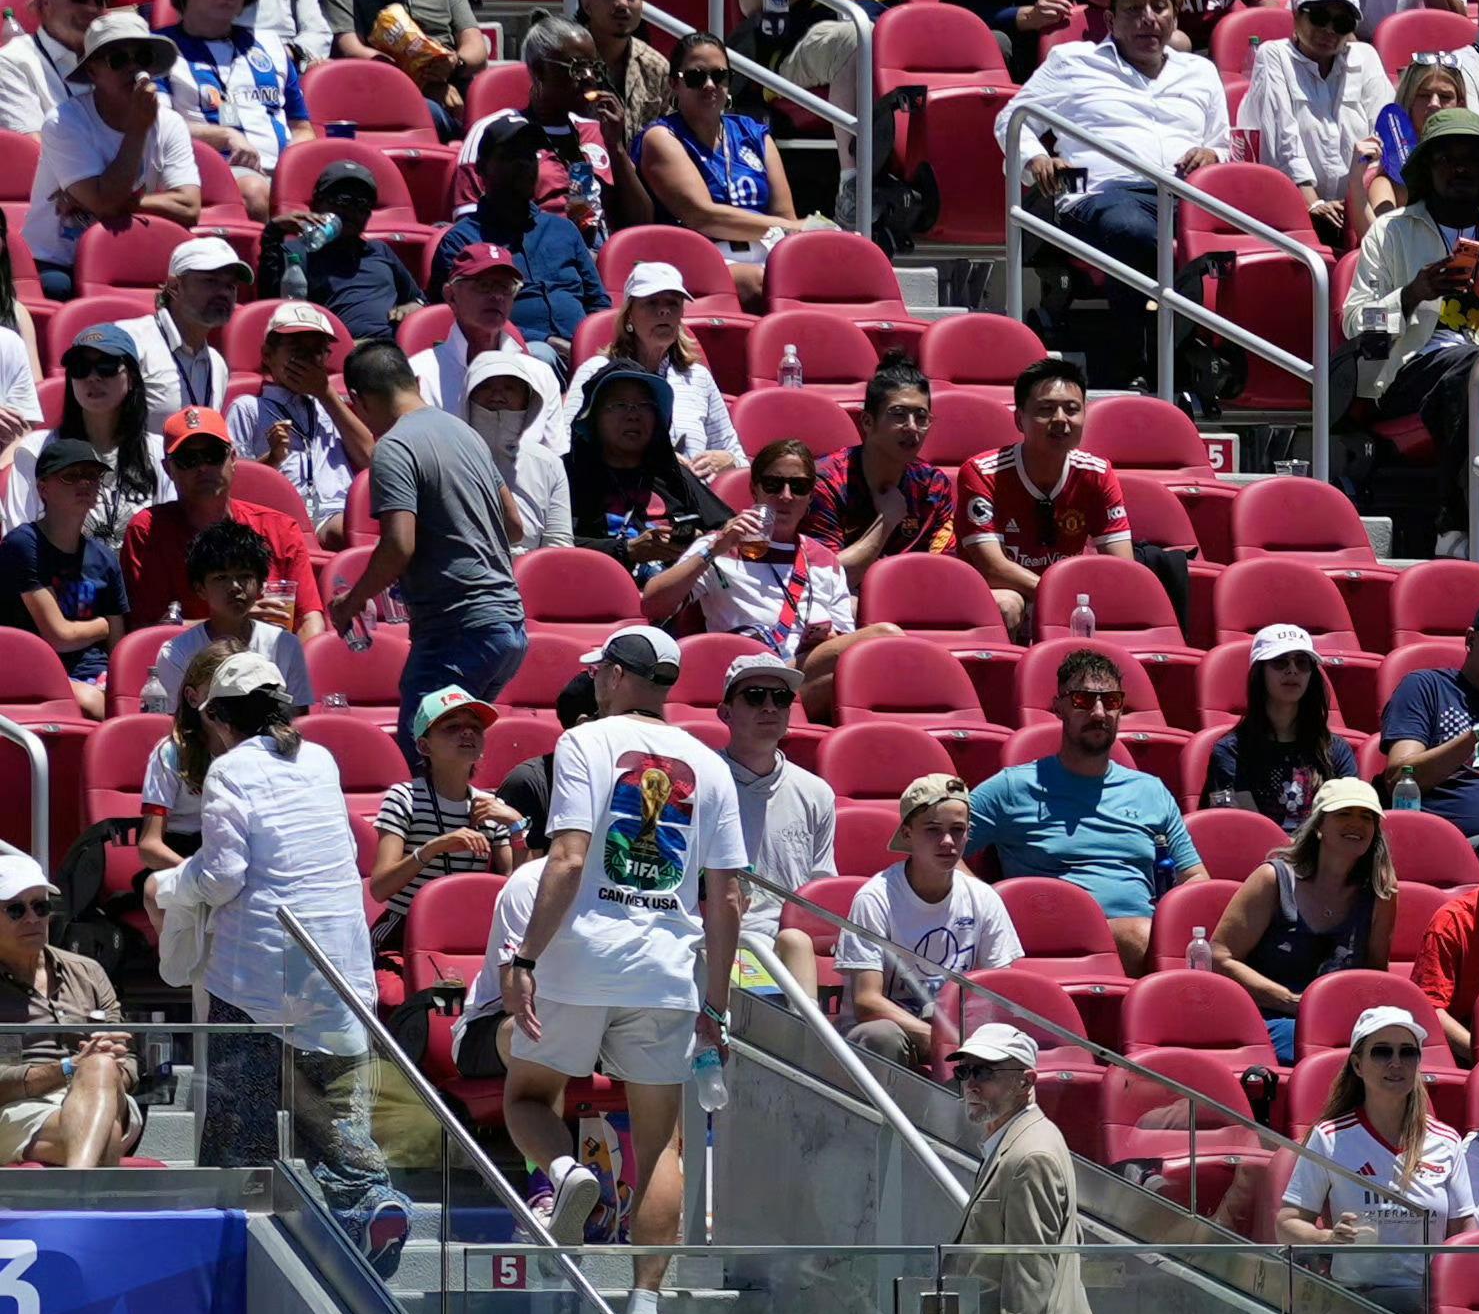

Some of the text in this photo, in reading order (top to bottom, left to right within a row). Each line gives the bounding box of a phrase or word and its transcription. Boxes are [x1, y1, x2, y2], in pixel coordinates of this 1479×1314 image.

[626, 858, 661, 879] FIFA
[599, 889, 678, 911] CAN MEX USA
[499, 1255, 518, 1285] 5
